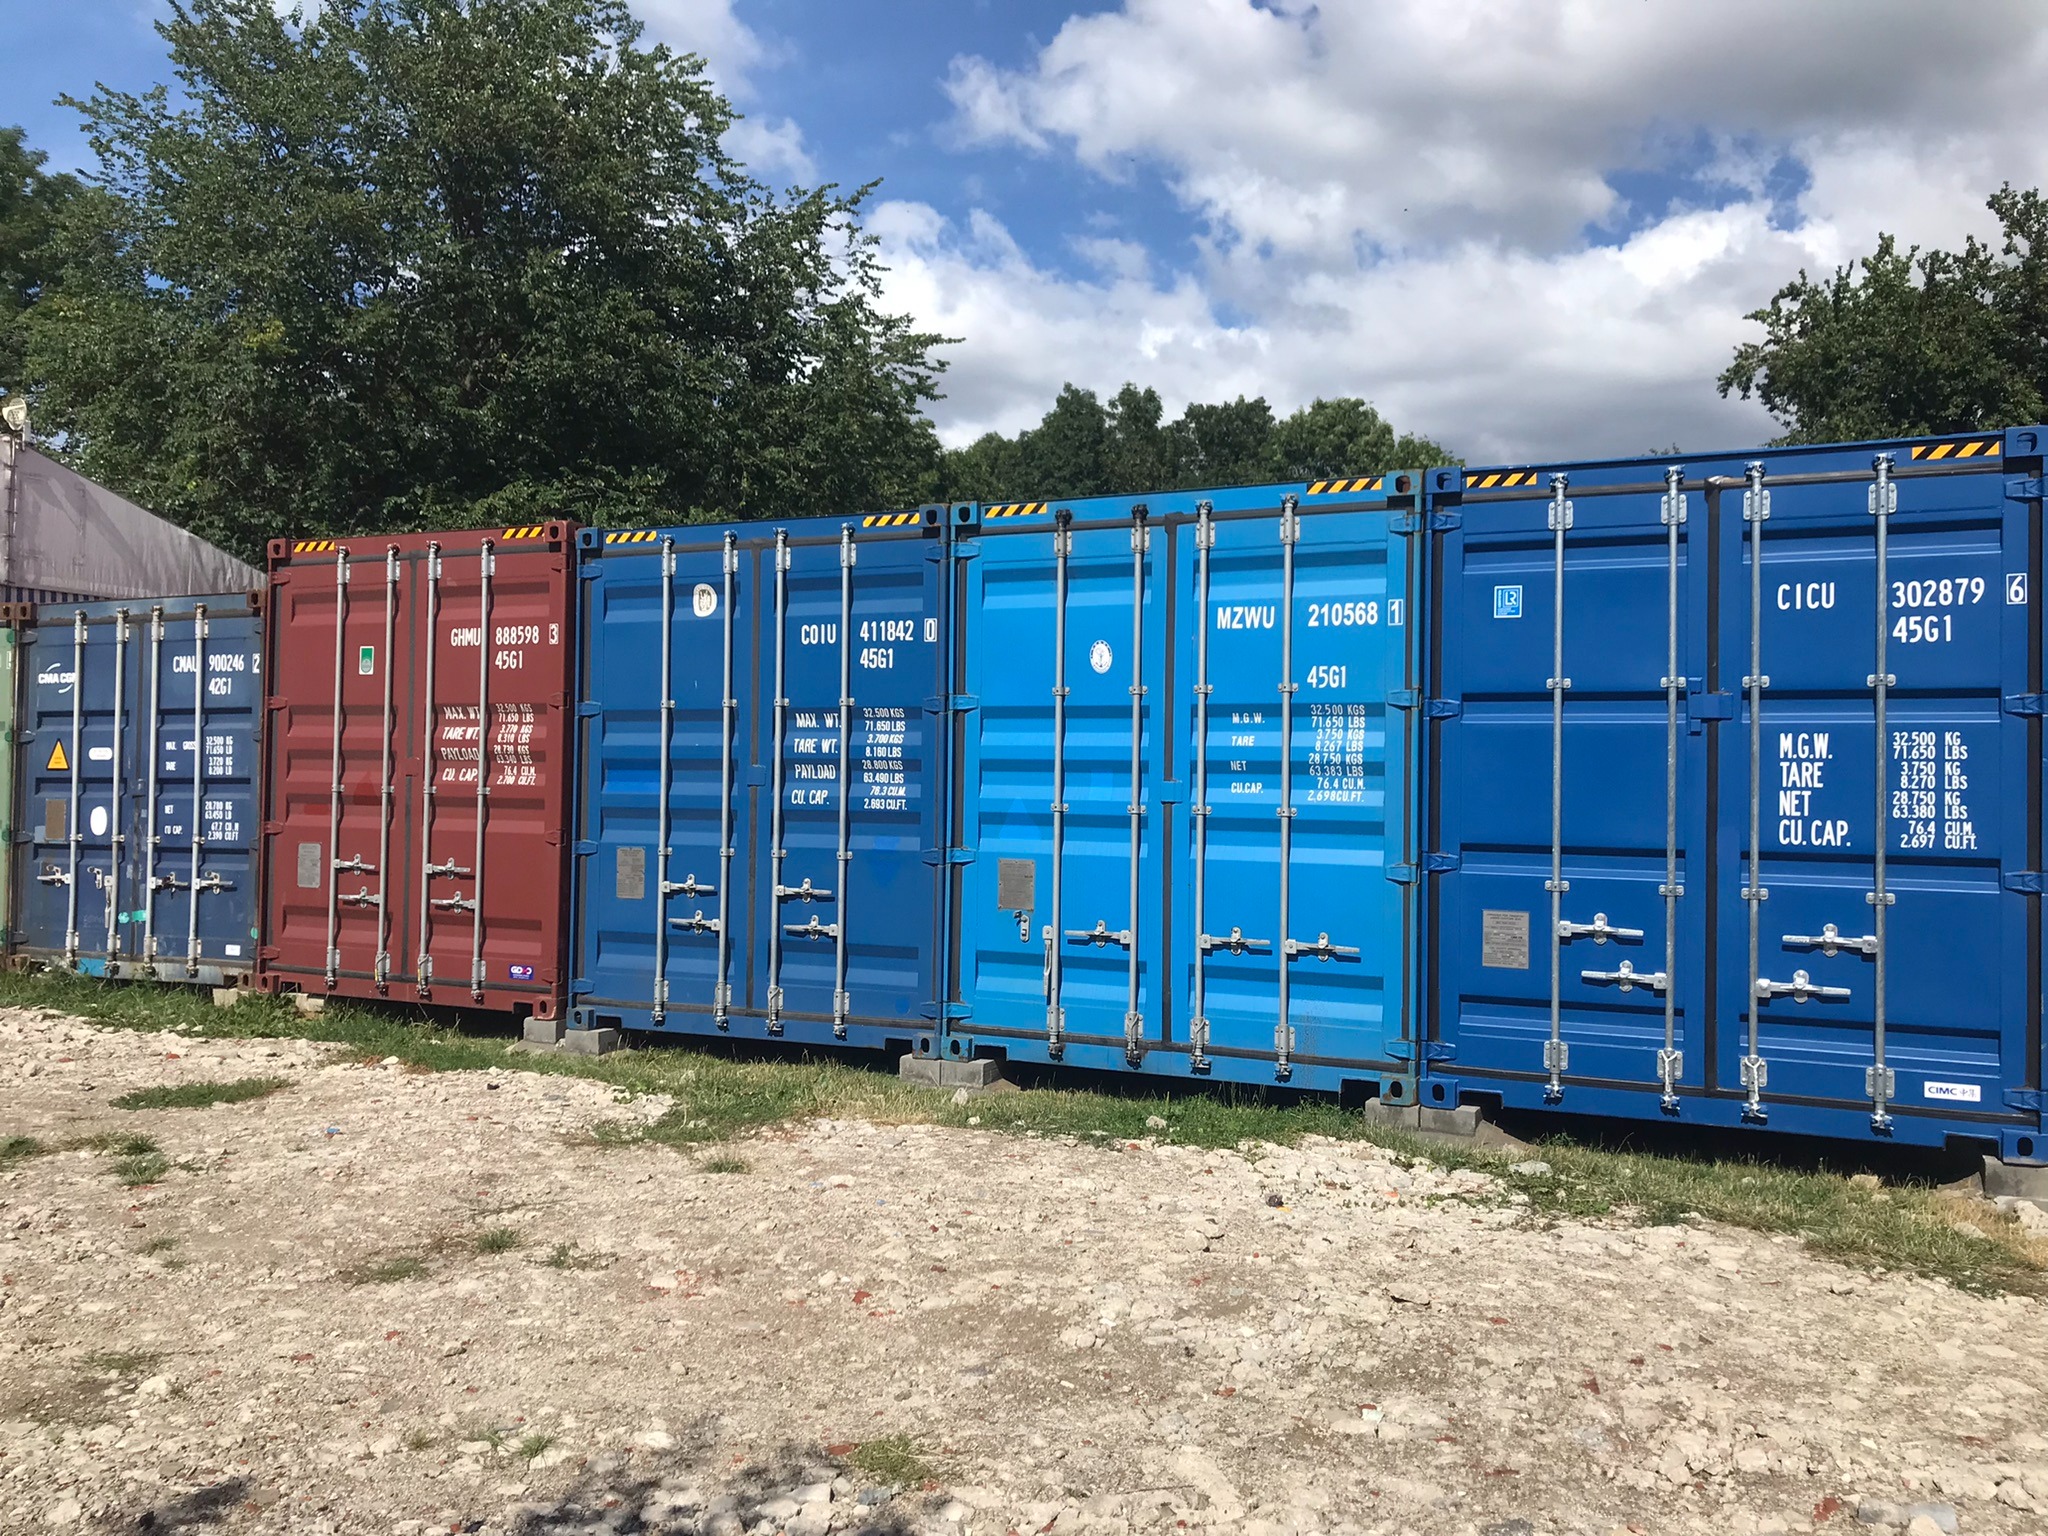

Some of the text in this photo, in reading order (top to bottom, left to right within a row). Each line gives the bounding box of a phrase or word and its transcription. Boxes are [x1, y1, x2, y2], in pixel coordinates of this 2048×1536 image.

[1777, 574, 2026, 610] CICU 302879 6
[1216, 600, 1401, 629] MZWU 210568 1
[450, 624, 558, 646] GHMU 888598 3
[801, 624, 836, 644] COIU
[860, 620, 914, 641] 411842
[1892, 615, 1952, 643] 45G1
[209, 654, 244, 672] 900246
[253, 654, 260, 673] 2
[495, 650, 523, 669] 45G1
[860, 648, 893, 669] 45G1
[38, 673, 59, 684] CMA
[1307, 665, 1346, 689] 45G1
[208, 677, 231, 695] 42G1
[443, 706, 466, 719] MAX.
[863, 708, 904, 718] 32.500 KGS
[1347, 704, 1365, 715] KGS
[795, 713, 820, 728] MAX.
[1232, 712, 1265, 724] M.G.W.
[1348, 716, 1366, 728] LBS
[865, 720, 906, 731] 71.650 LBS
[442, 726, 466, 740] TARE
[889, 733, 904, 744] KGS
[1347, 728, 1365, 740] KGS
[1944, 731, 1961, 746] KG
[794, 738, 838, 754] TARE WT.
[1231, 735, 1255, 746] TARE
[1345, 740, 1364, 752] LBS
[1779, 733, 1833, 759] M.G.W.
[440, 747, 480, 761] PAYLOAD
[865, 746, 902, 757] 8.160 LBS
[1944, 745, 1968, 760] LBS
[889, 760, 903, 770] KGS
[1230, 760, 1247, 771] NET
[1345, 753, 1363, 765] KGS
[442, 768, 478, 781] CU. CAP.
[794, 764, 836, 779] PAYLOAD
[1346, 765, 1364, 777] LBS
[1780, 761, 1824, 788] TARE
[1944, 761, 1961, 776] KG
[863, 772, 904, 784] 63.490 LBS
[1317, 777, 1339, 789] 76.4
[1944, 775, 1968, 789] LBS
[870, 786, 887, 796] 76.3
[1231, 782, 1264, 794] CU.CAP.
[791, 789, 830, 805] CU. CAP.
[864, 798, 885, 809] 2.693
[1779, 790, 1812, 816] NET
[1944, 791, 1961, 805] KG
[1944, 805, 1968, 820] LBS
[1779, 819, 1851, 846] CU. CAP.
[1908, 820, 1975, 836] 76.4 CU.M.
[1928, 1086, 1957, 1096] CIMC
